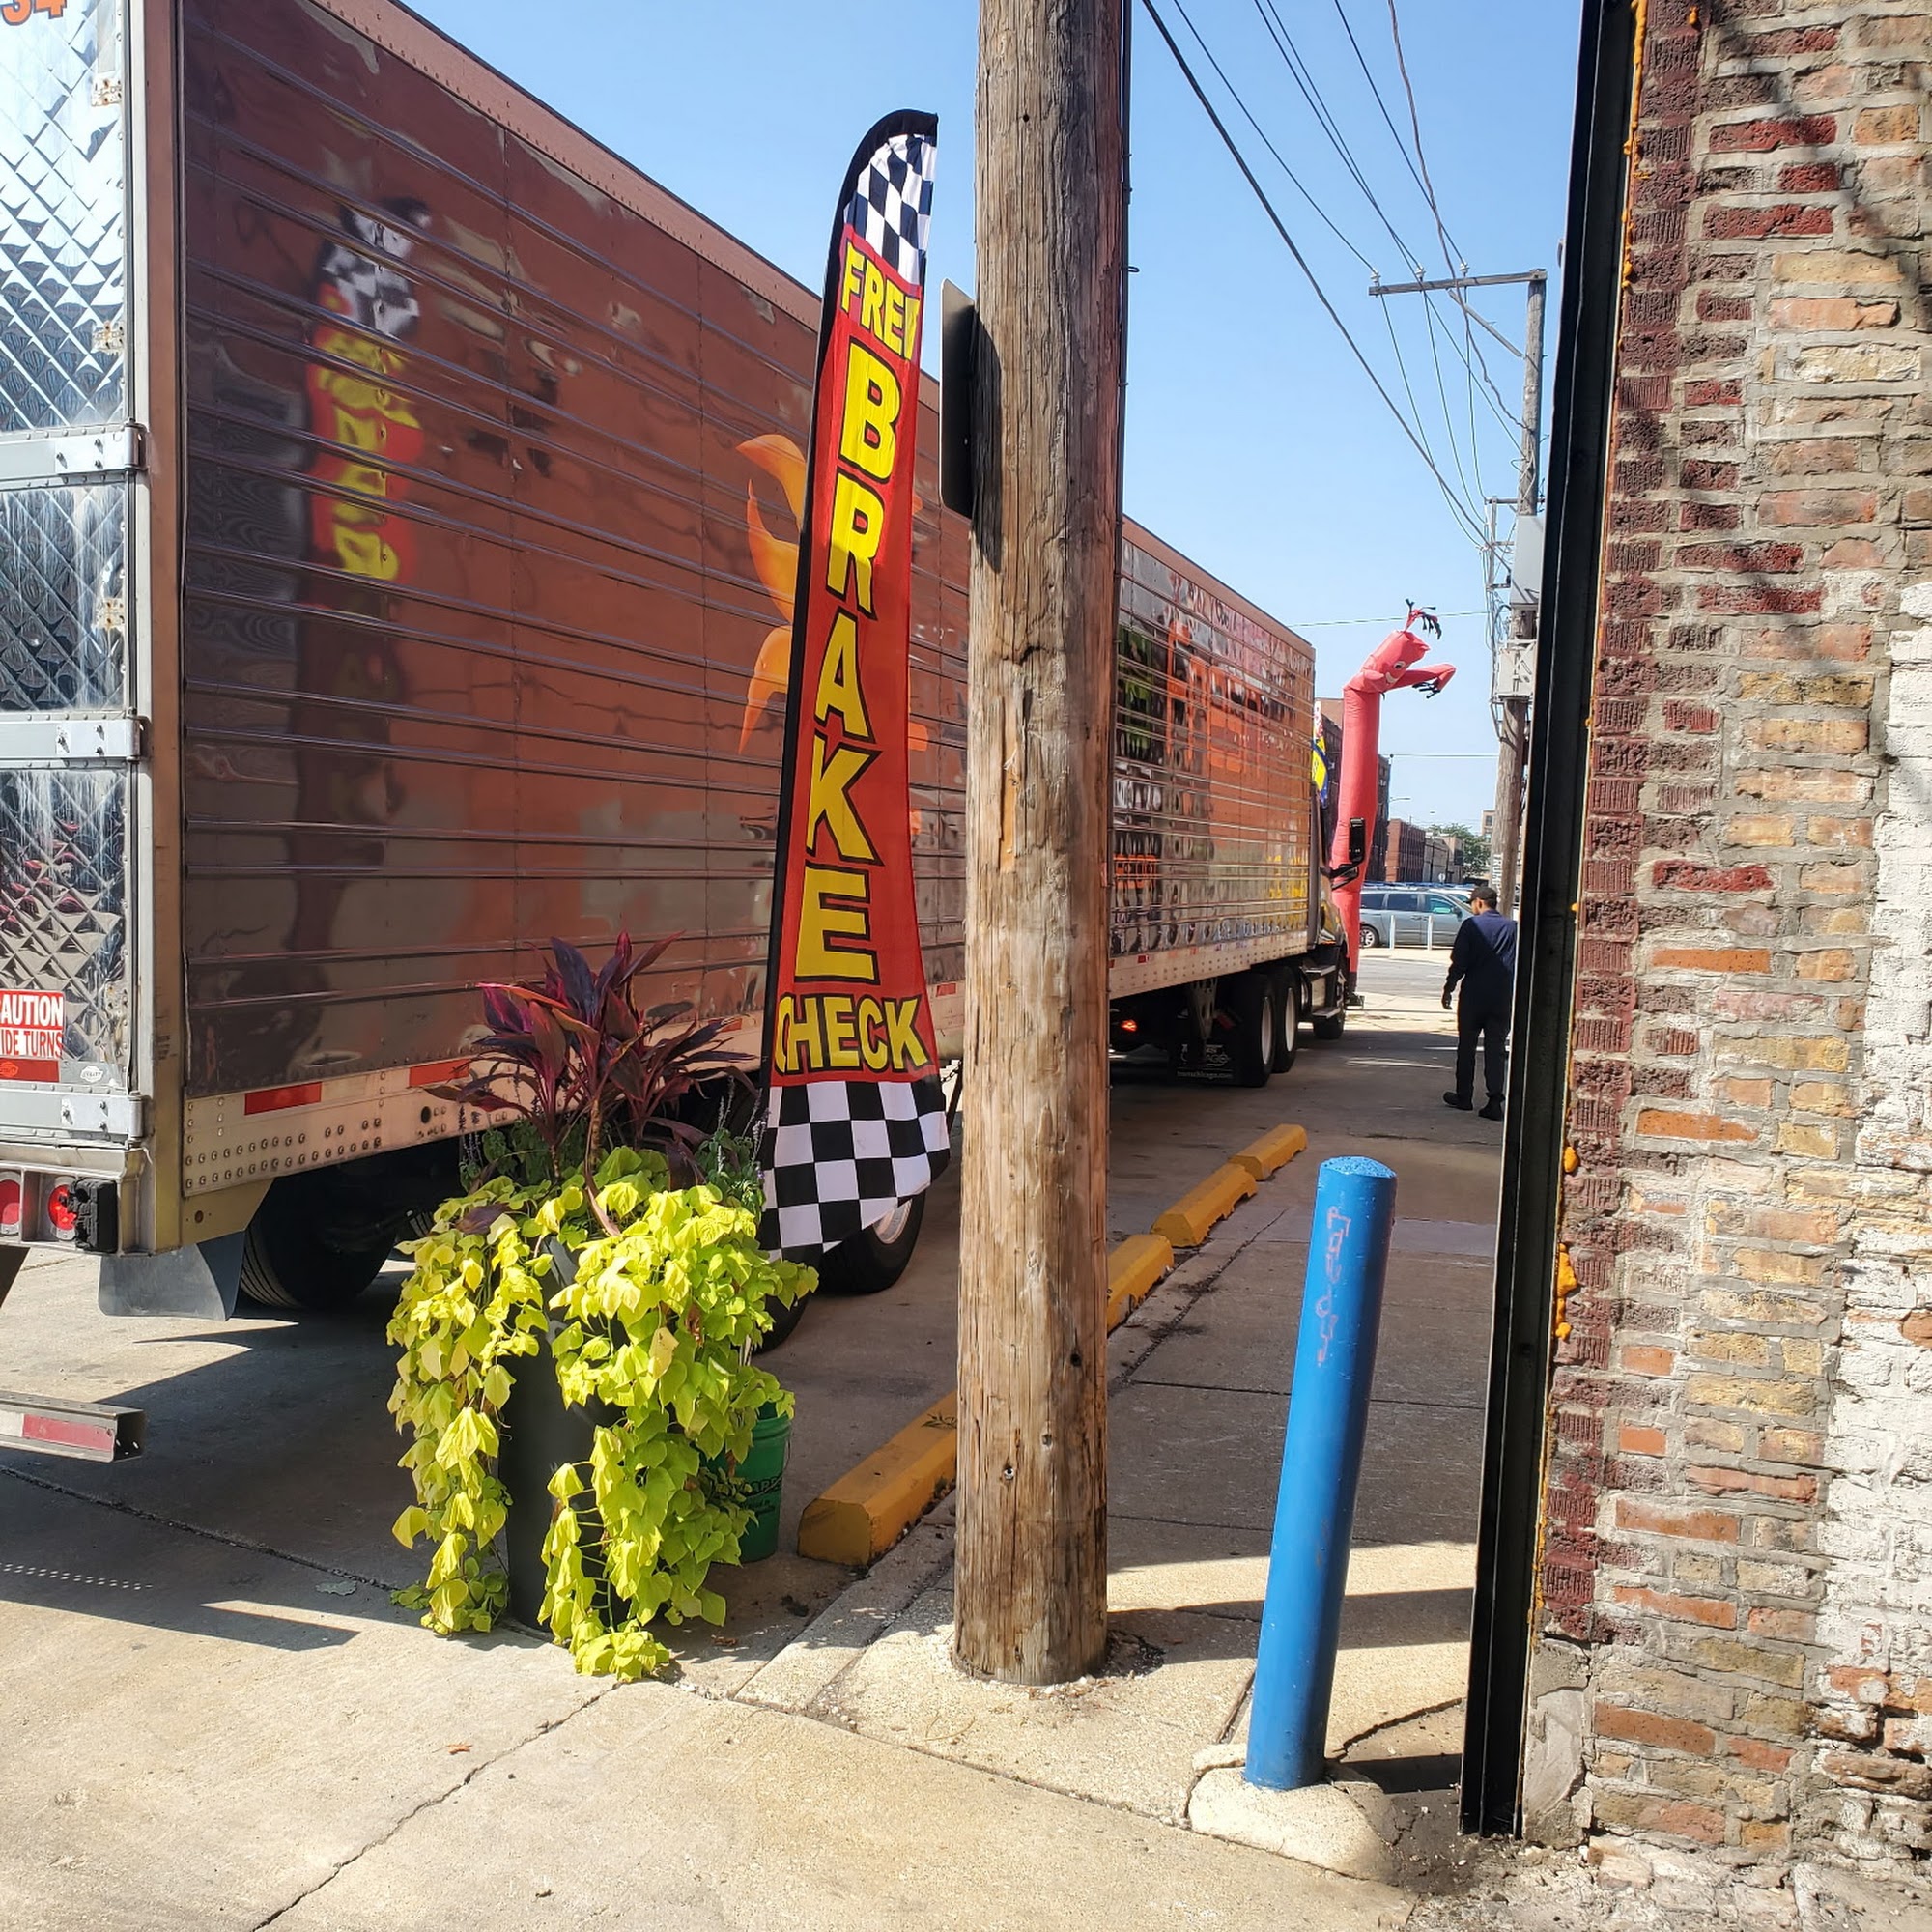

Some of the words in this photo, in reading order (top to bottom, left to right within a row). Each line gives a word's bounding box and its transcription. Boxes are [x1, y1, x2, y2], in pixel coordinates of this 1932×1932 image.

[790, 336, 902, 985] BRAKE
[0, 993, 64, 1027] AUTION
[774, 993, 929, 1075] CHECK
[0, 1029, 19, 1055] IDE
[23, 1030, 64, 1059] TURNS
